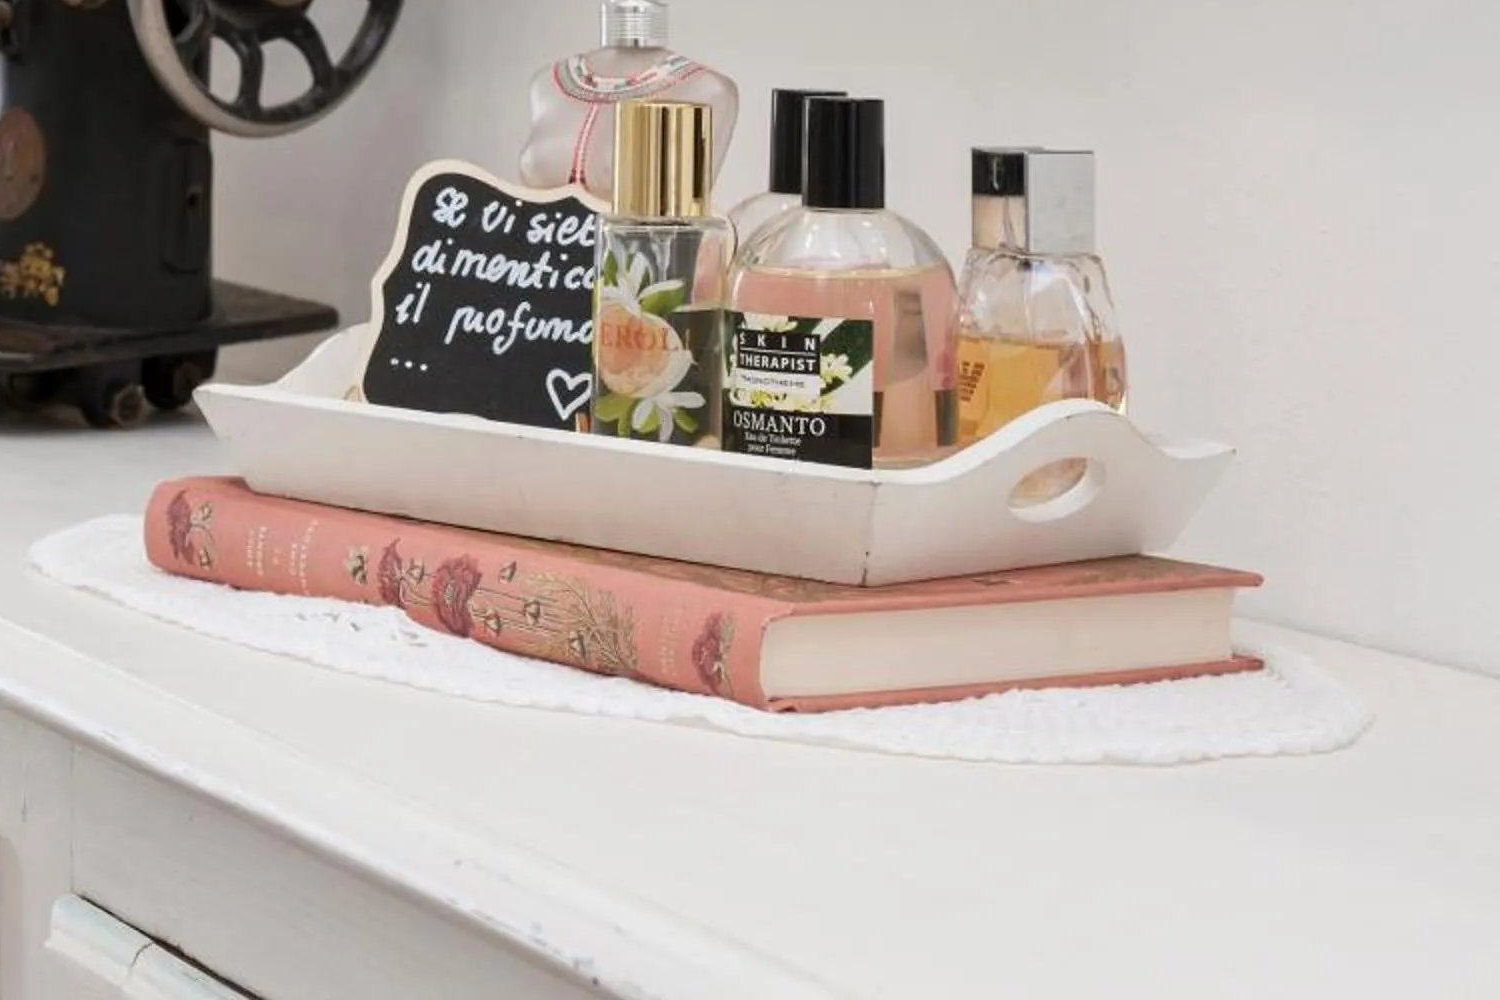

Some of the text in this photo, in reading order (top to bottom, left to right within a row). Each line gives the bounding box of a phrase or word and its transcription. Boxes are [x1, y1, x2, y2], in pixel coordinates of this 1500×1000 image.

[396, 282, 431, 325] il
[739, 332, 816, 352] SKIN
[739, 352, 817, 372] THERAPIST
[733, 410, 826, 437] OSMANTO
